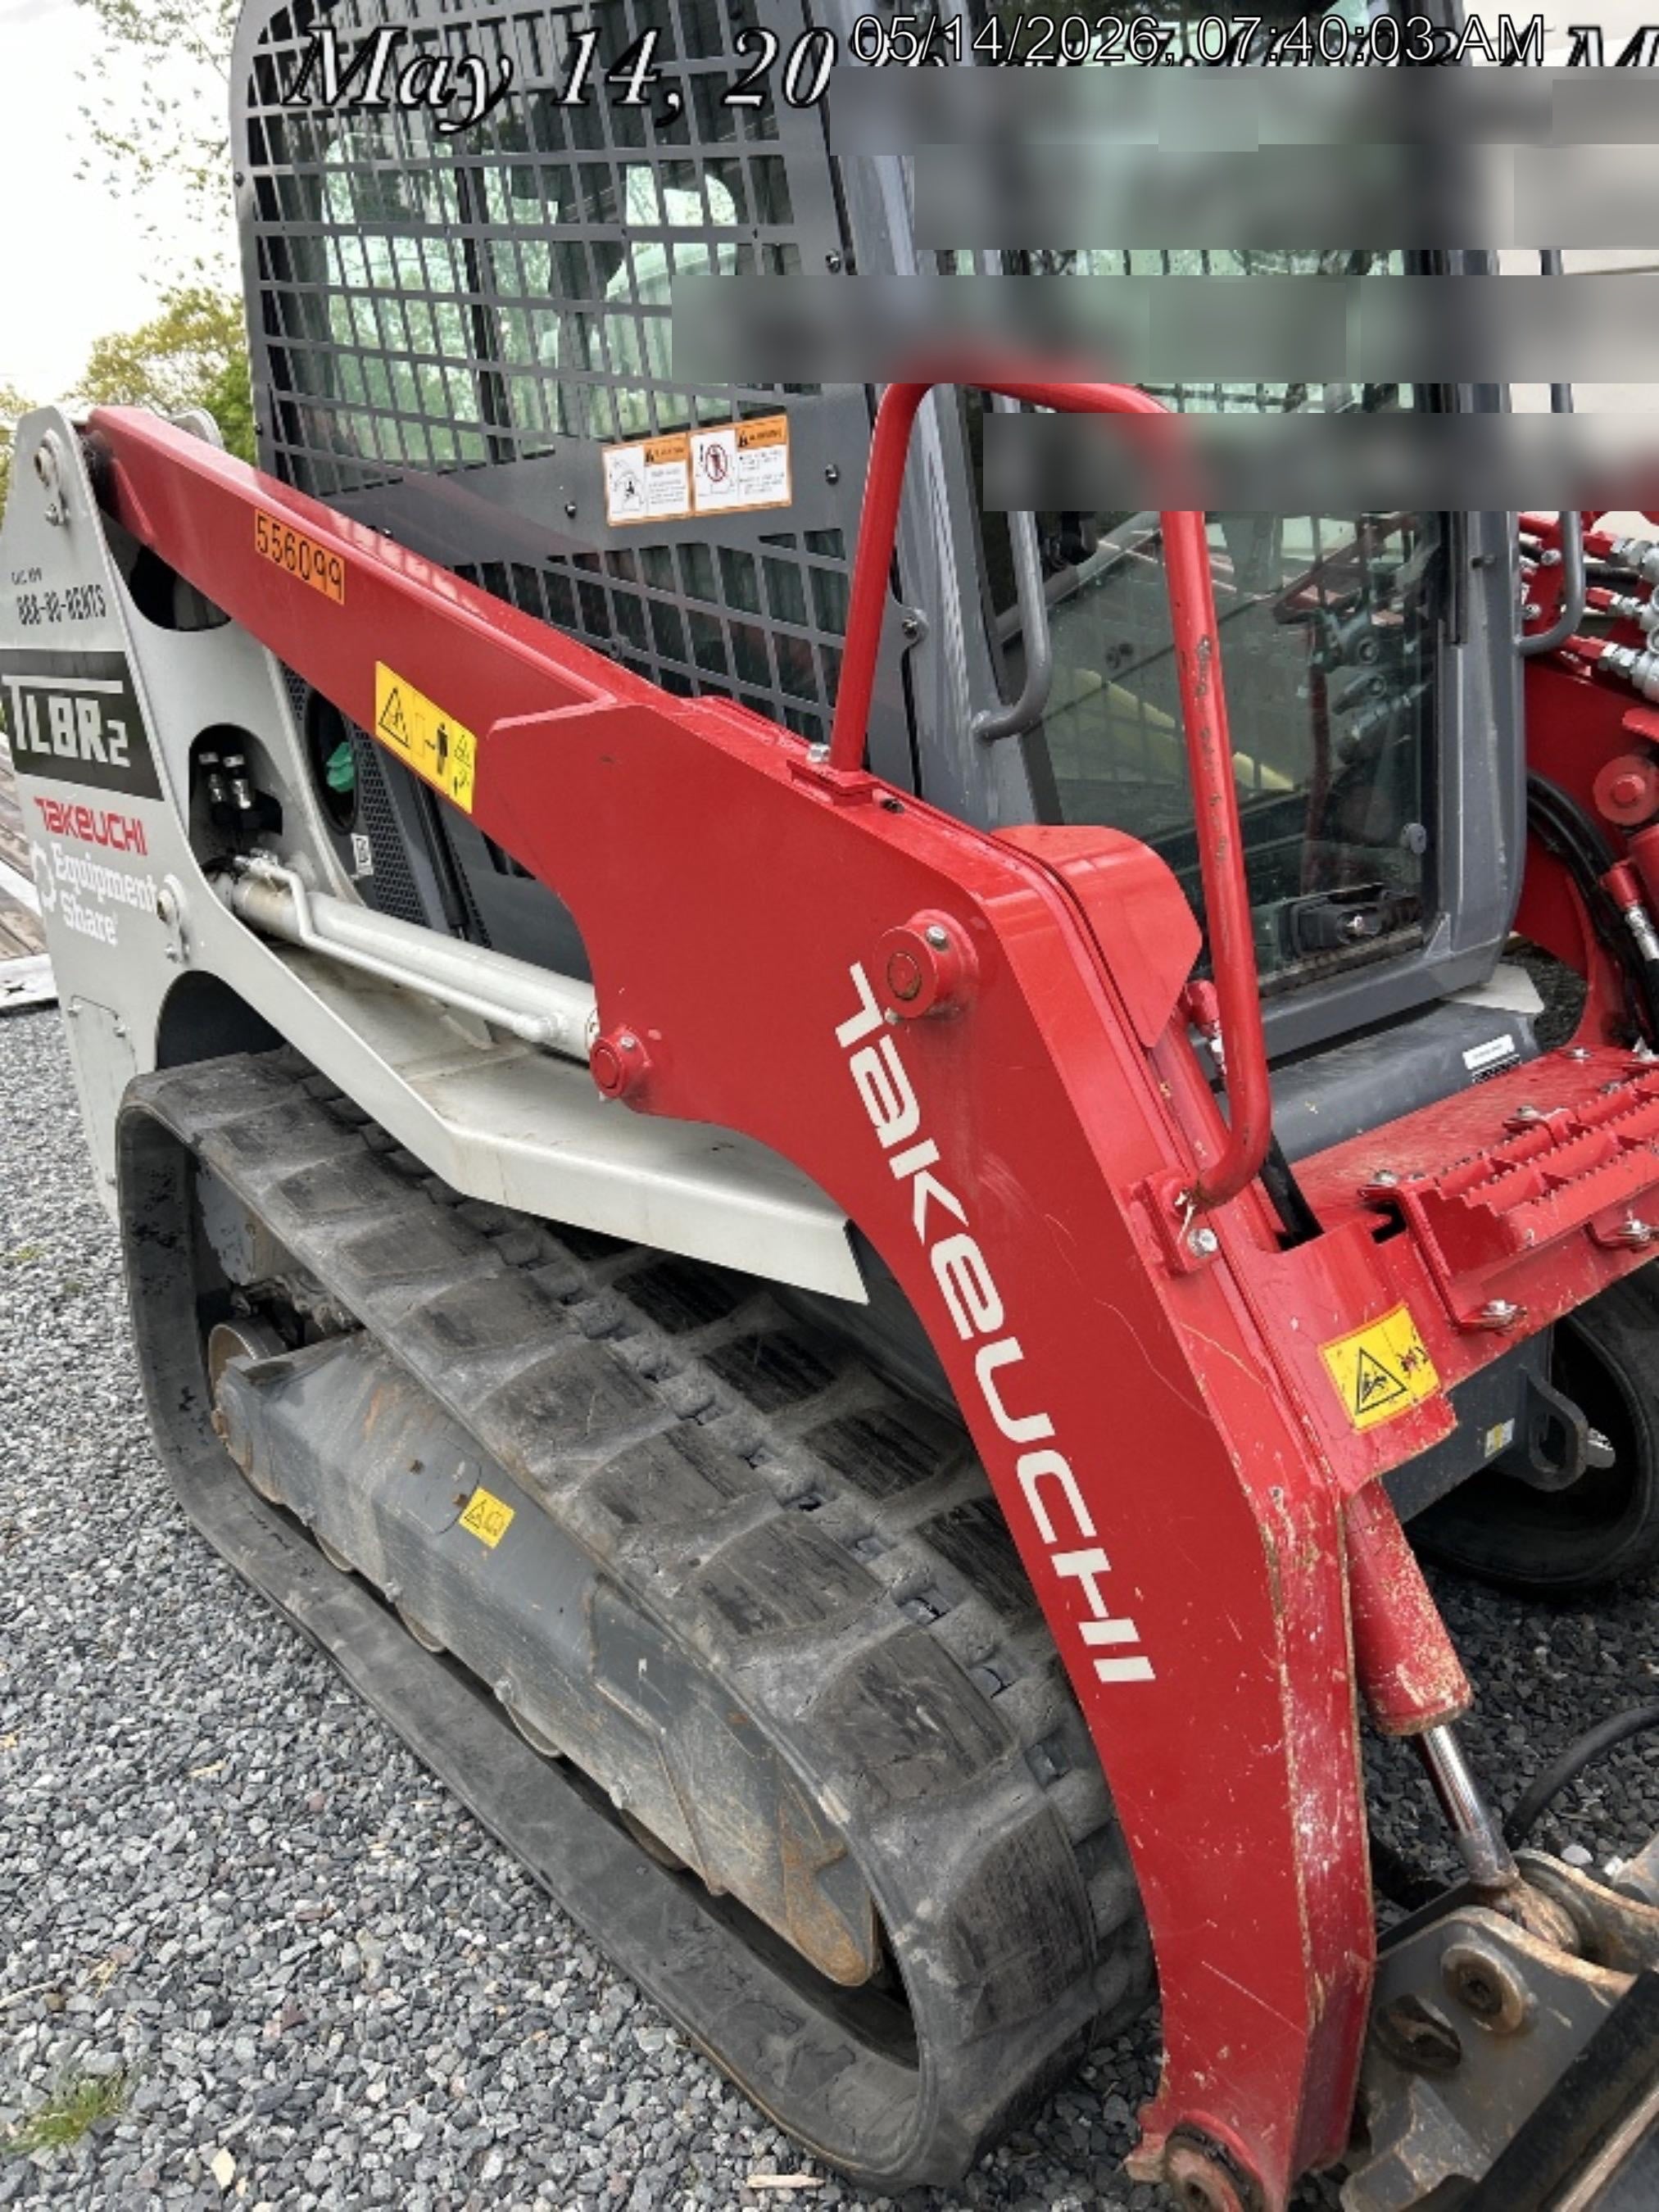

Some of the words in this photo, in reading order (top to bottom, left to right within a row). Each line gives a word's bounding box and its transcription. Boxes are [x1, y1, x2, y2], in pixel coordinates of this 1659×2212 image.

[257, 514, 342, 601] 556099
[50, 841, 159, 915] Equipment
[60, 890, 120, 946] Share
